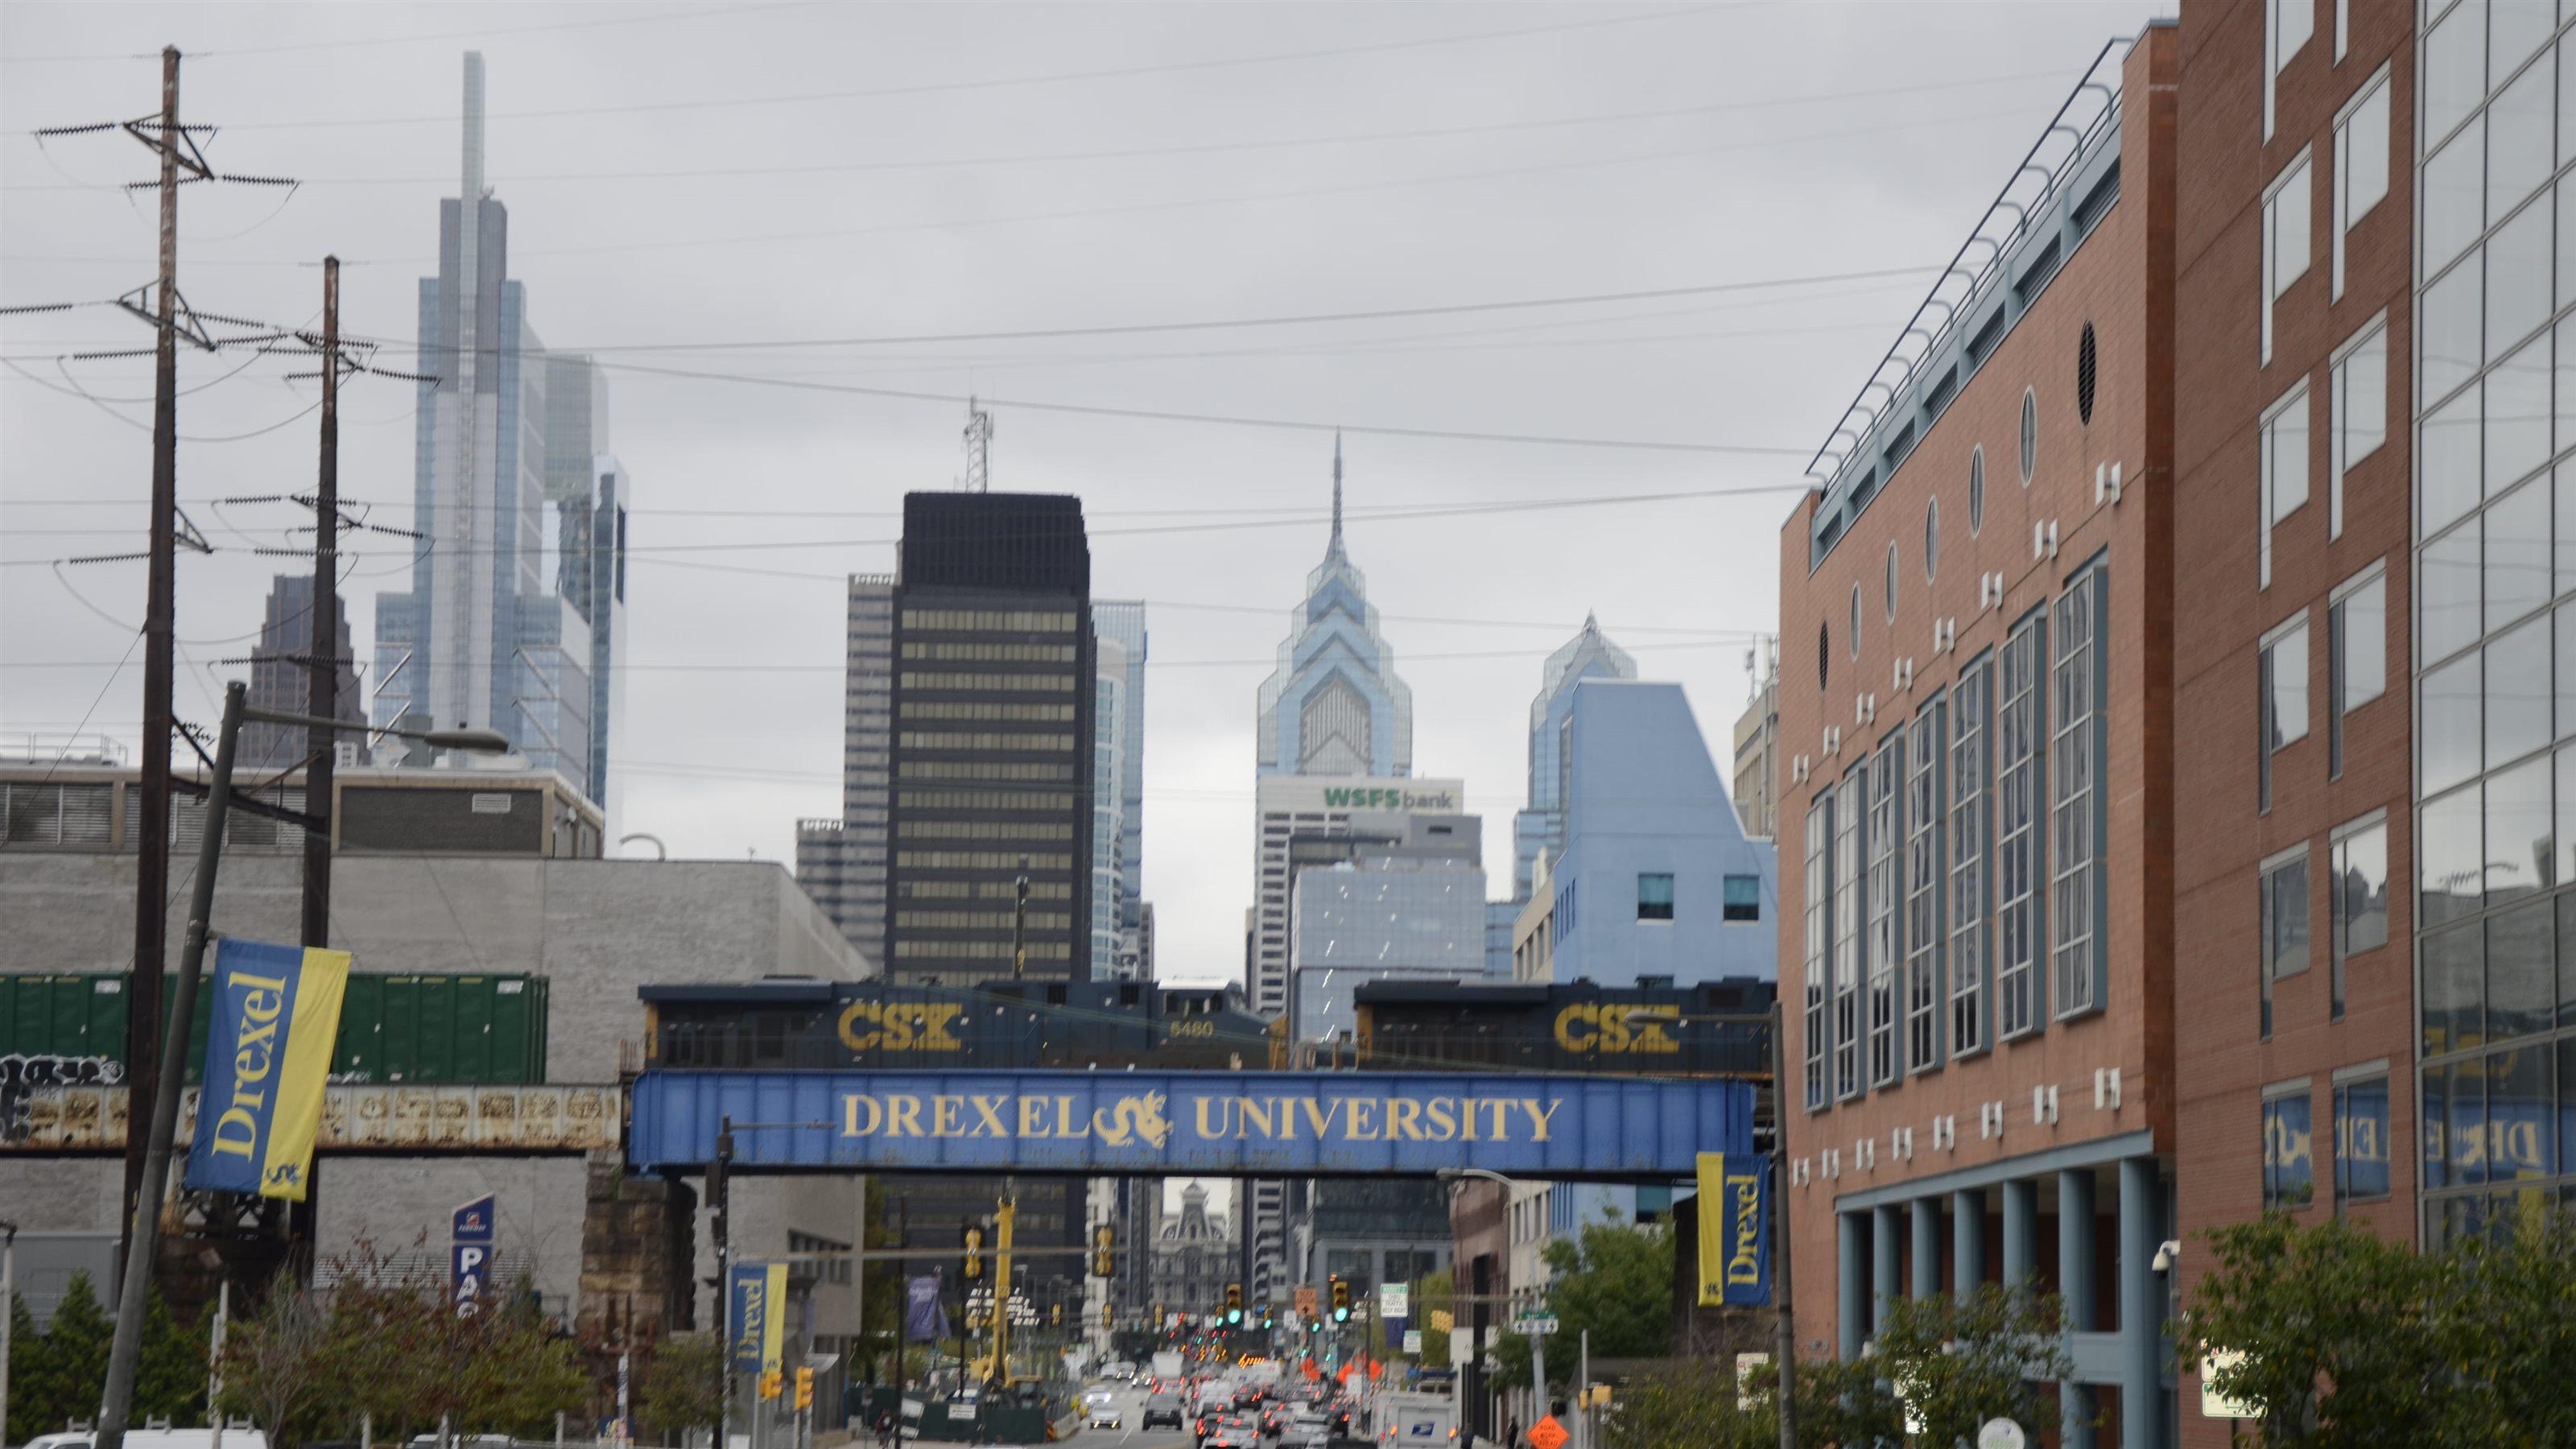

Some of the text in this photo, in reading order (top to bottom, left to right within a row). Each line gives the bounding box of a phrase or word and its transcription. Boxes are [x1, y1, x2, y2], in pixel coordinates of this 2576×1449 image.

[1324, 788, 1453, 808] WSFS bank
[838, 1003, 962, 1051] CSX
[211, 972, 287, 1164] Drexel
[840, 1095, 1563, 1142] DREXEL UNIVERSITY
[1726, 1174, 1759, 1288] Drexel
[736, 1278, 763, 1360] Drexel
